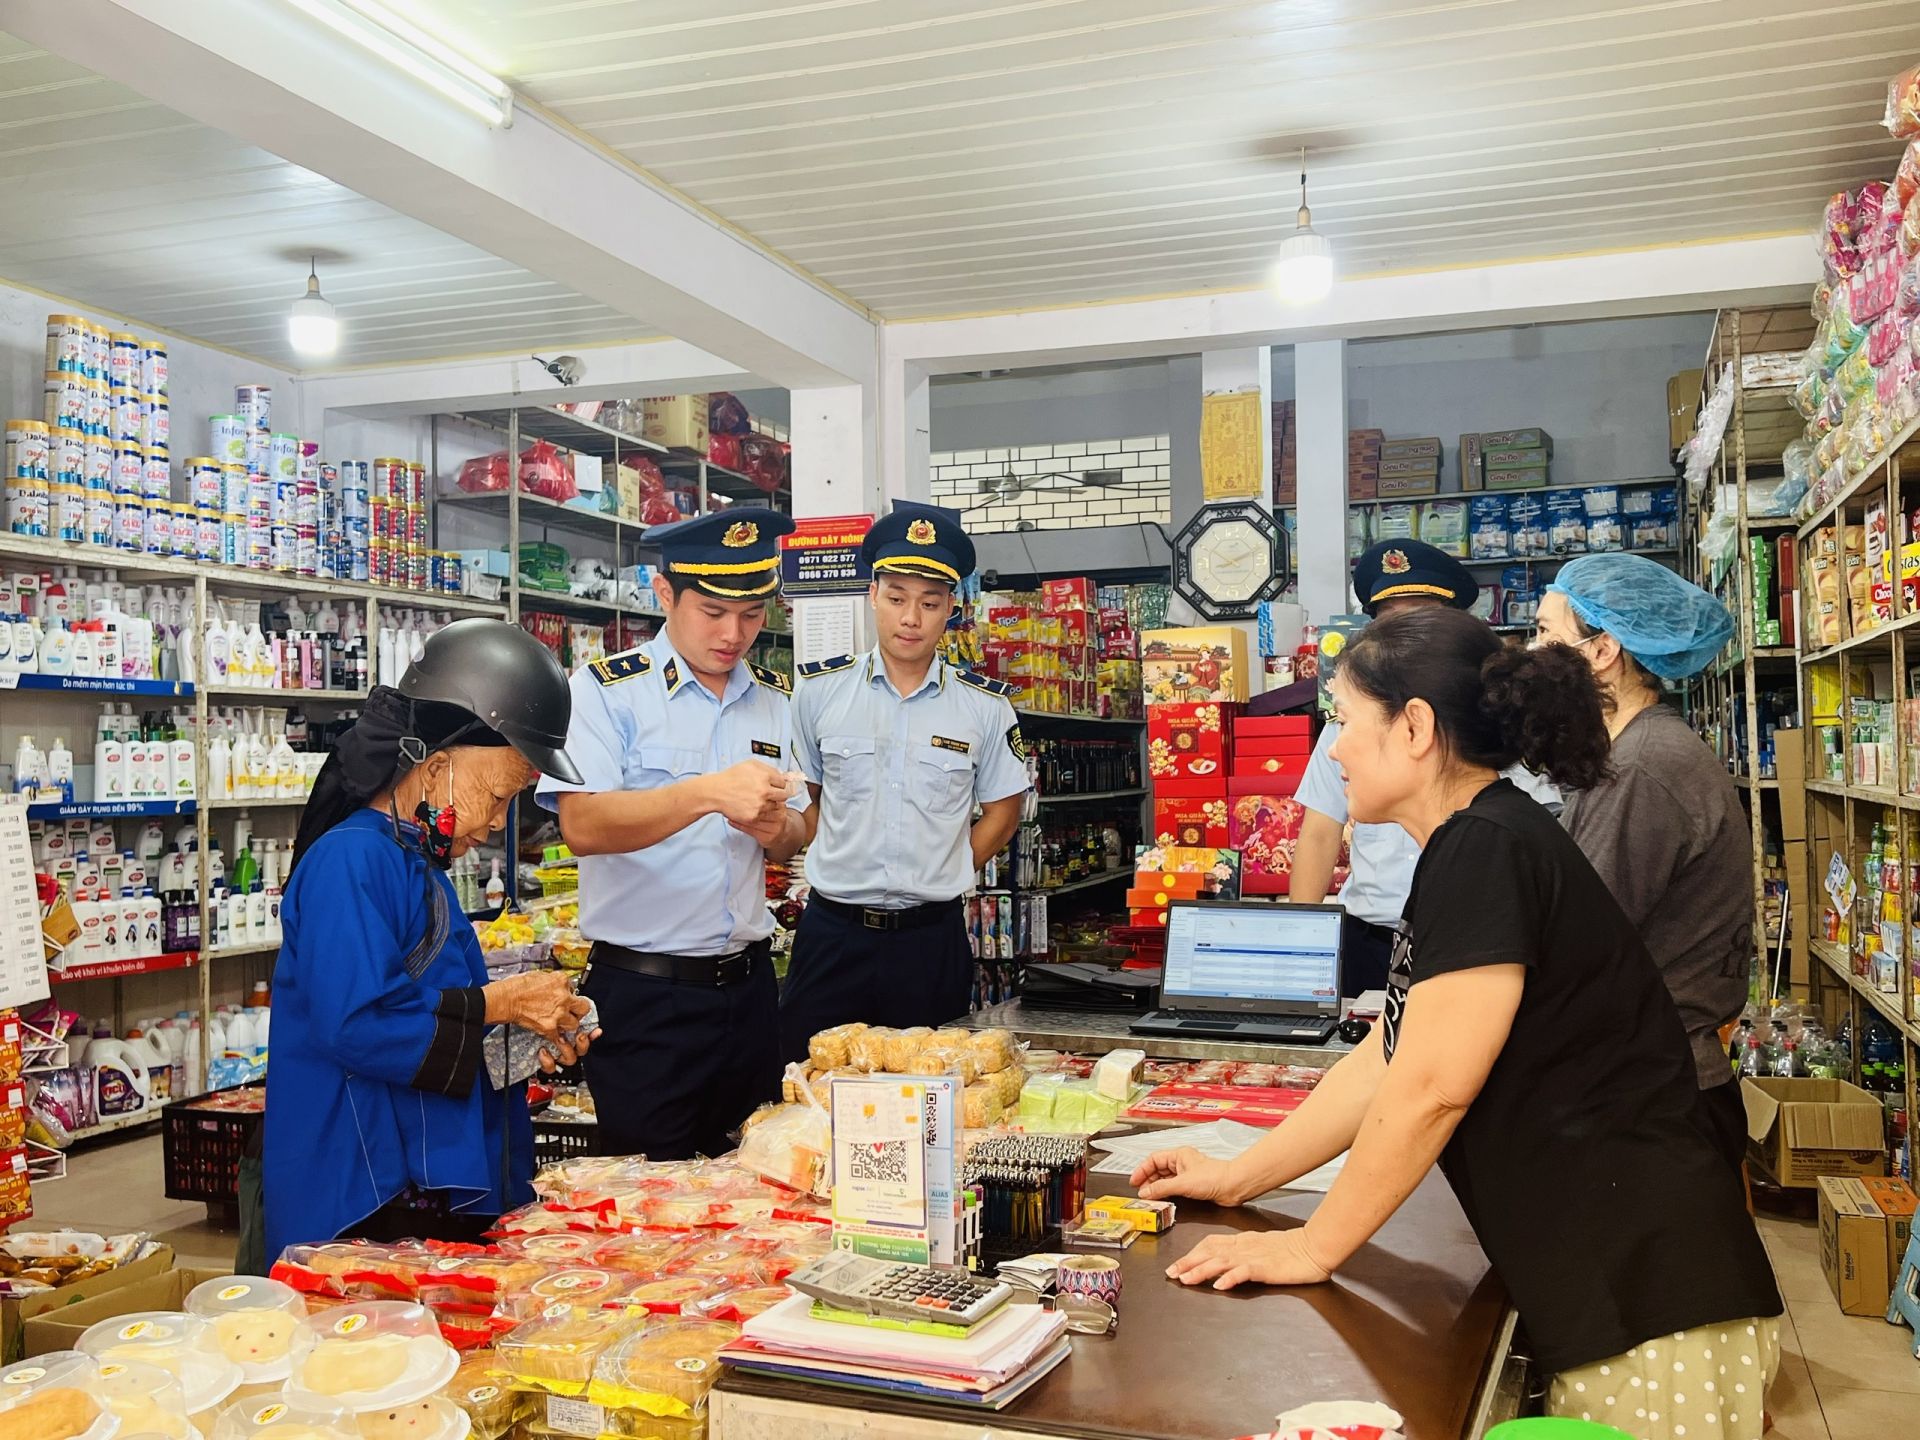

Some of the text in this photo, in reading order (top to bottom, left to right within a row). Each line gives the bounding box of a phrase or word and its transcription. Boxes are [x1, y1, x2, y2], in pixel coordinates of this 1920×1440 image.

[820, 534, 839, 546] DÂY
[996, 614, 1018, 627] Tipo
[126, 803, 144, 812] 99%
